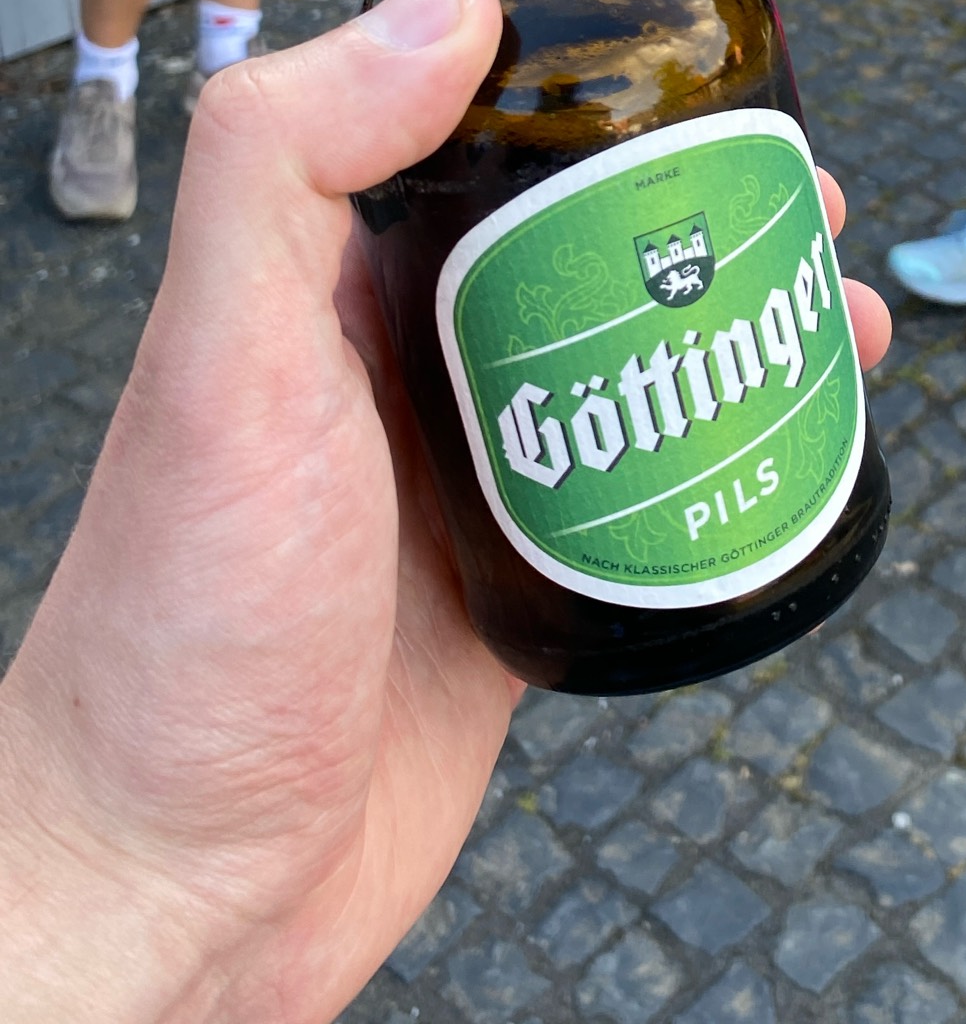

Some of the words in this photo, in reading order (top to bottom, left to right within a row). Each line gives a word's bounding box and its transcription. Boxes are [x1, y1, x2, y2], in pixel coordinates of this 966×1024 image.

[635, 167, 681, 191] MARKE
[497, 232, 832, 489] Göttinger
[581, 553, 620, 574] NACH
[624, 556, 717, 576] KLASSISCHER
[720, 521, 789, 563] GÖTTINGER
[791, 437, 849, 525] BRAUTRADITION
[684, 457, 780, 541] PILS
